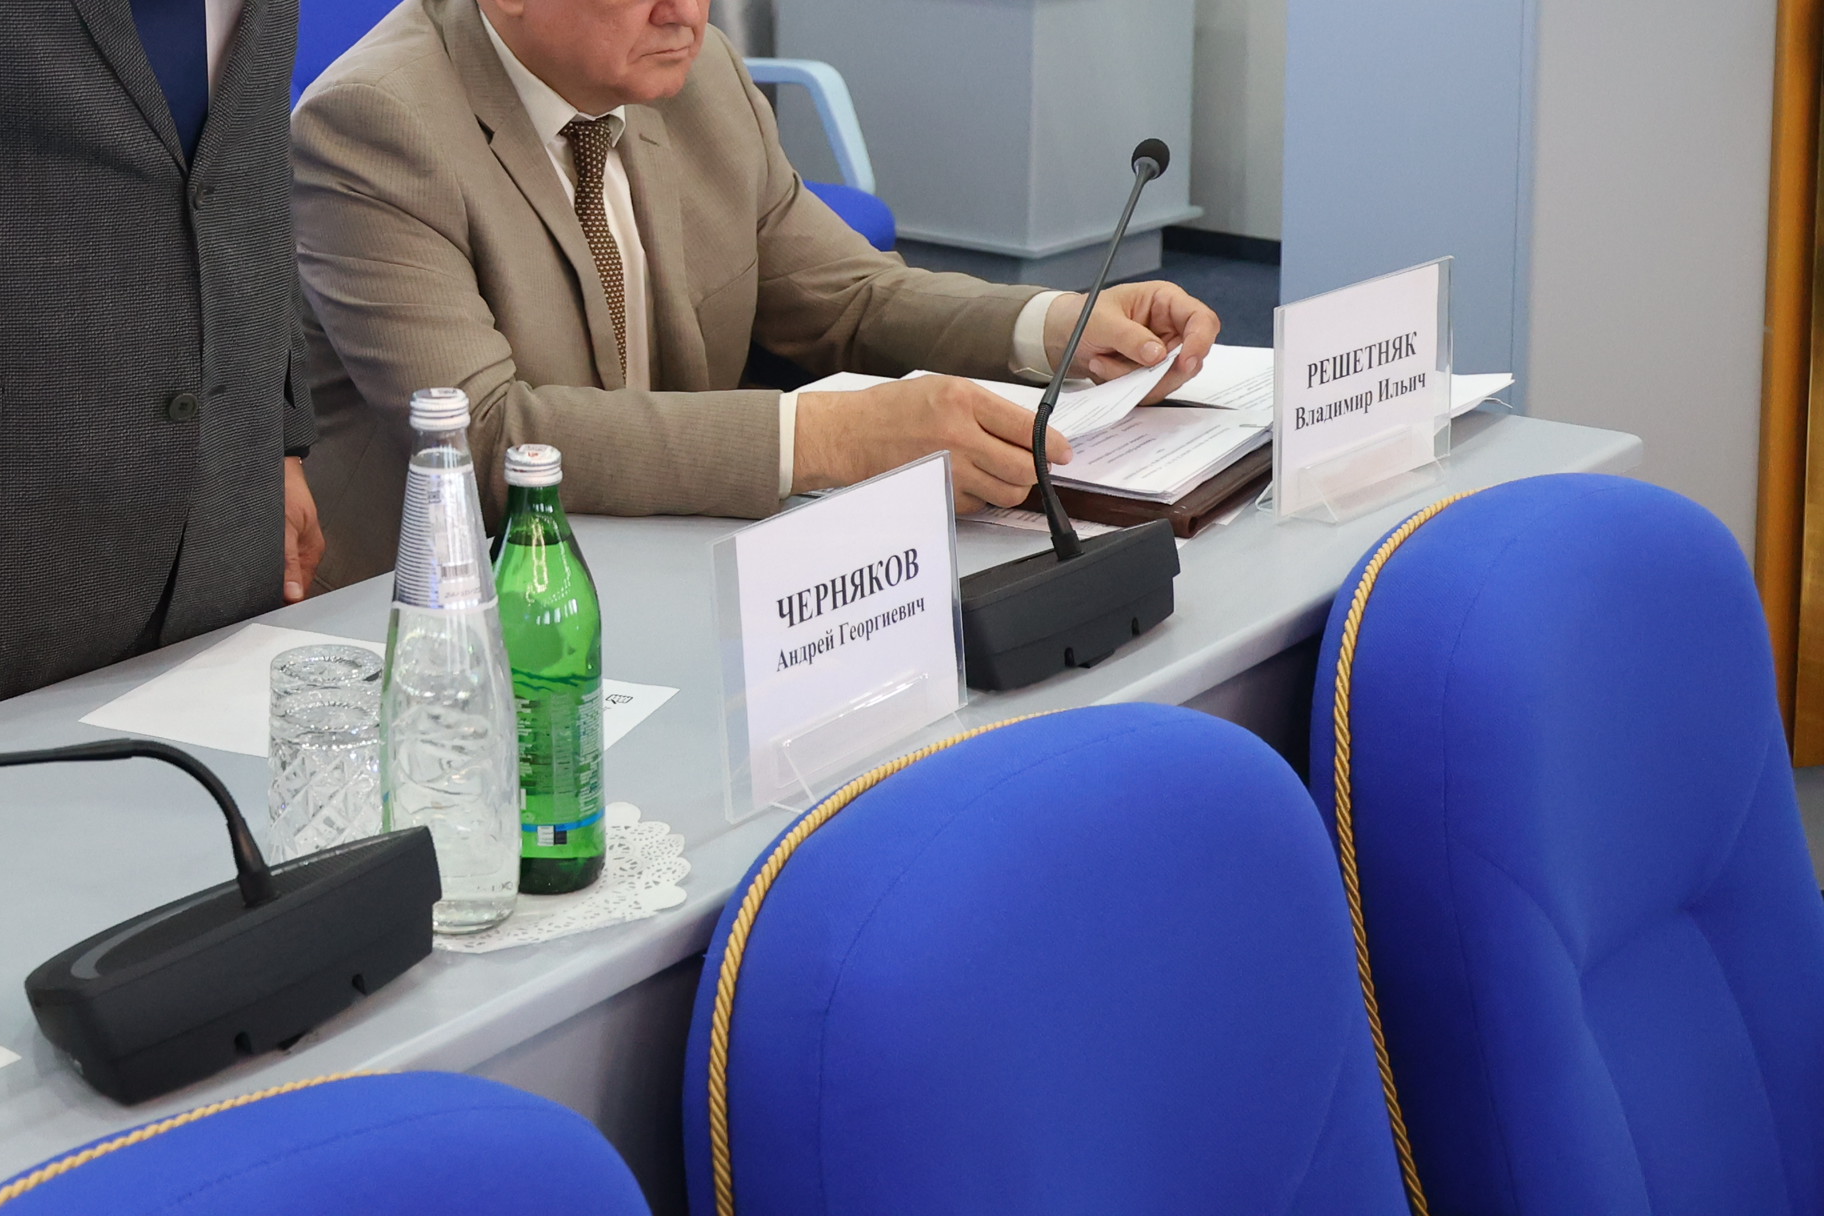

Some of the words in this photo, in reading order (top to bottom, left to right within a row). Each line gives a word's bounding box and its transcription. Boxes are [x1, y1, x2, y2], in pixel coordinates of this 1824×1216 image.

[1306, 330, 1418, 390] РЕШЕТНЯК
[1294, 389, 1373, 431] Владимир
[1377, 372, 1427, 403] Ильич
[776, 547, 920, 628] ЧЕРНЯКОВ
[776, 630, 835, 672] Андрей
[838, 596, 926, 645] Георгиевич
